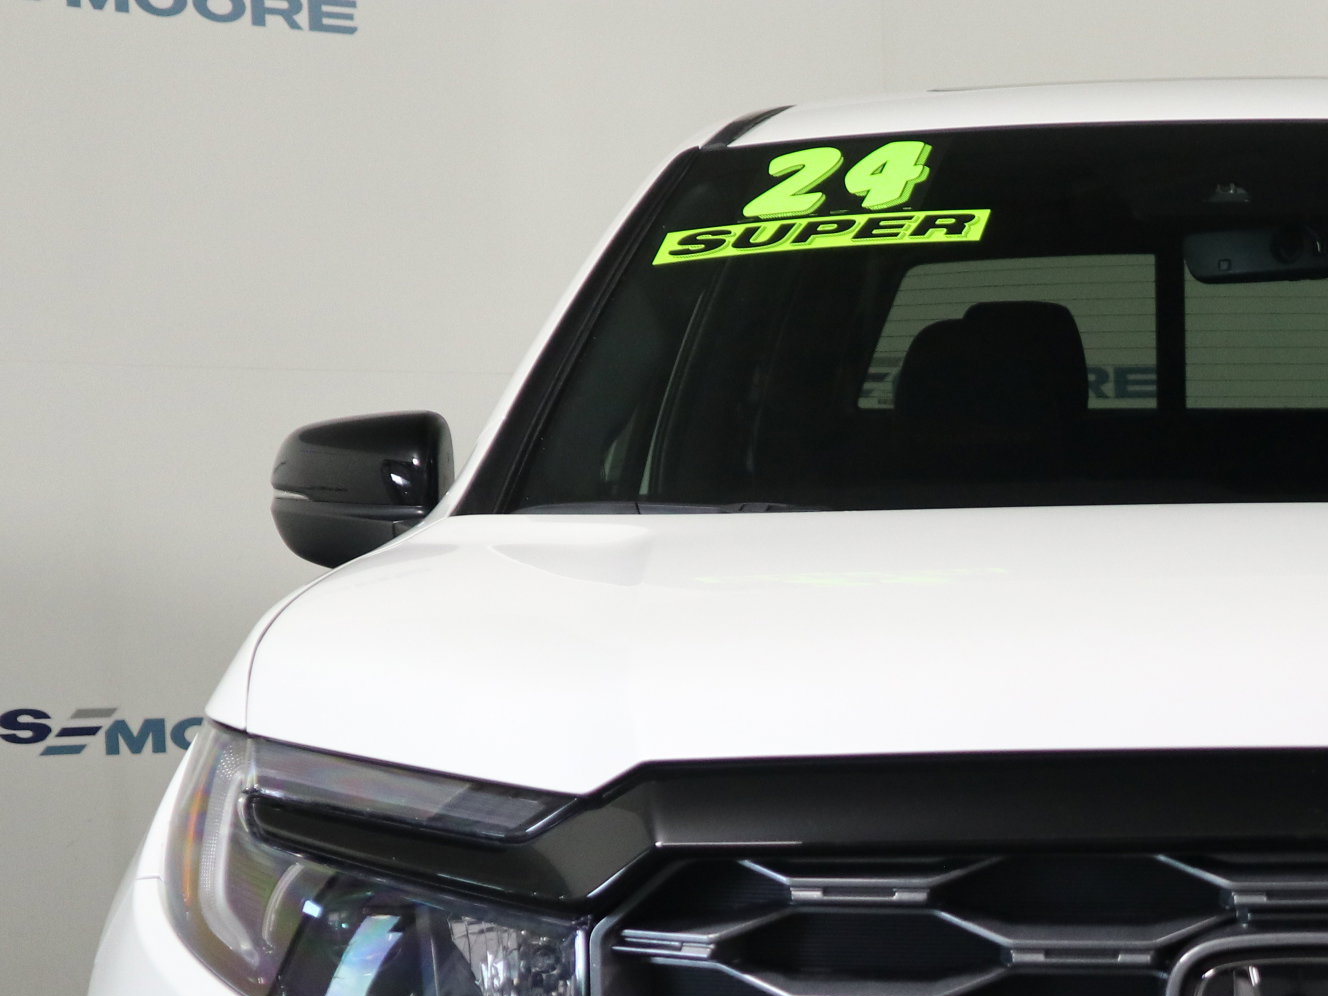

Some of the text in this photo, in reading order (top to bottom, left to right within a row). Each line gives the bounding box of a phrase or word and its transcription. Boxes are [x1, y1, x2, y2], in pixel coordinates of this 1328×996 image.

[66, 0, 357, 35] ORE
[743, 141, 932, 219] 24
[668, 213, 981, 259] SUPER
